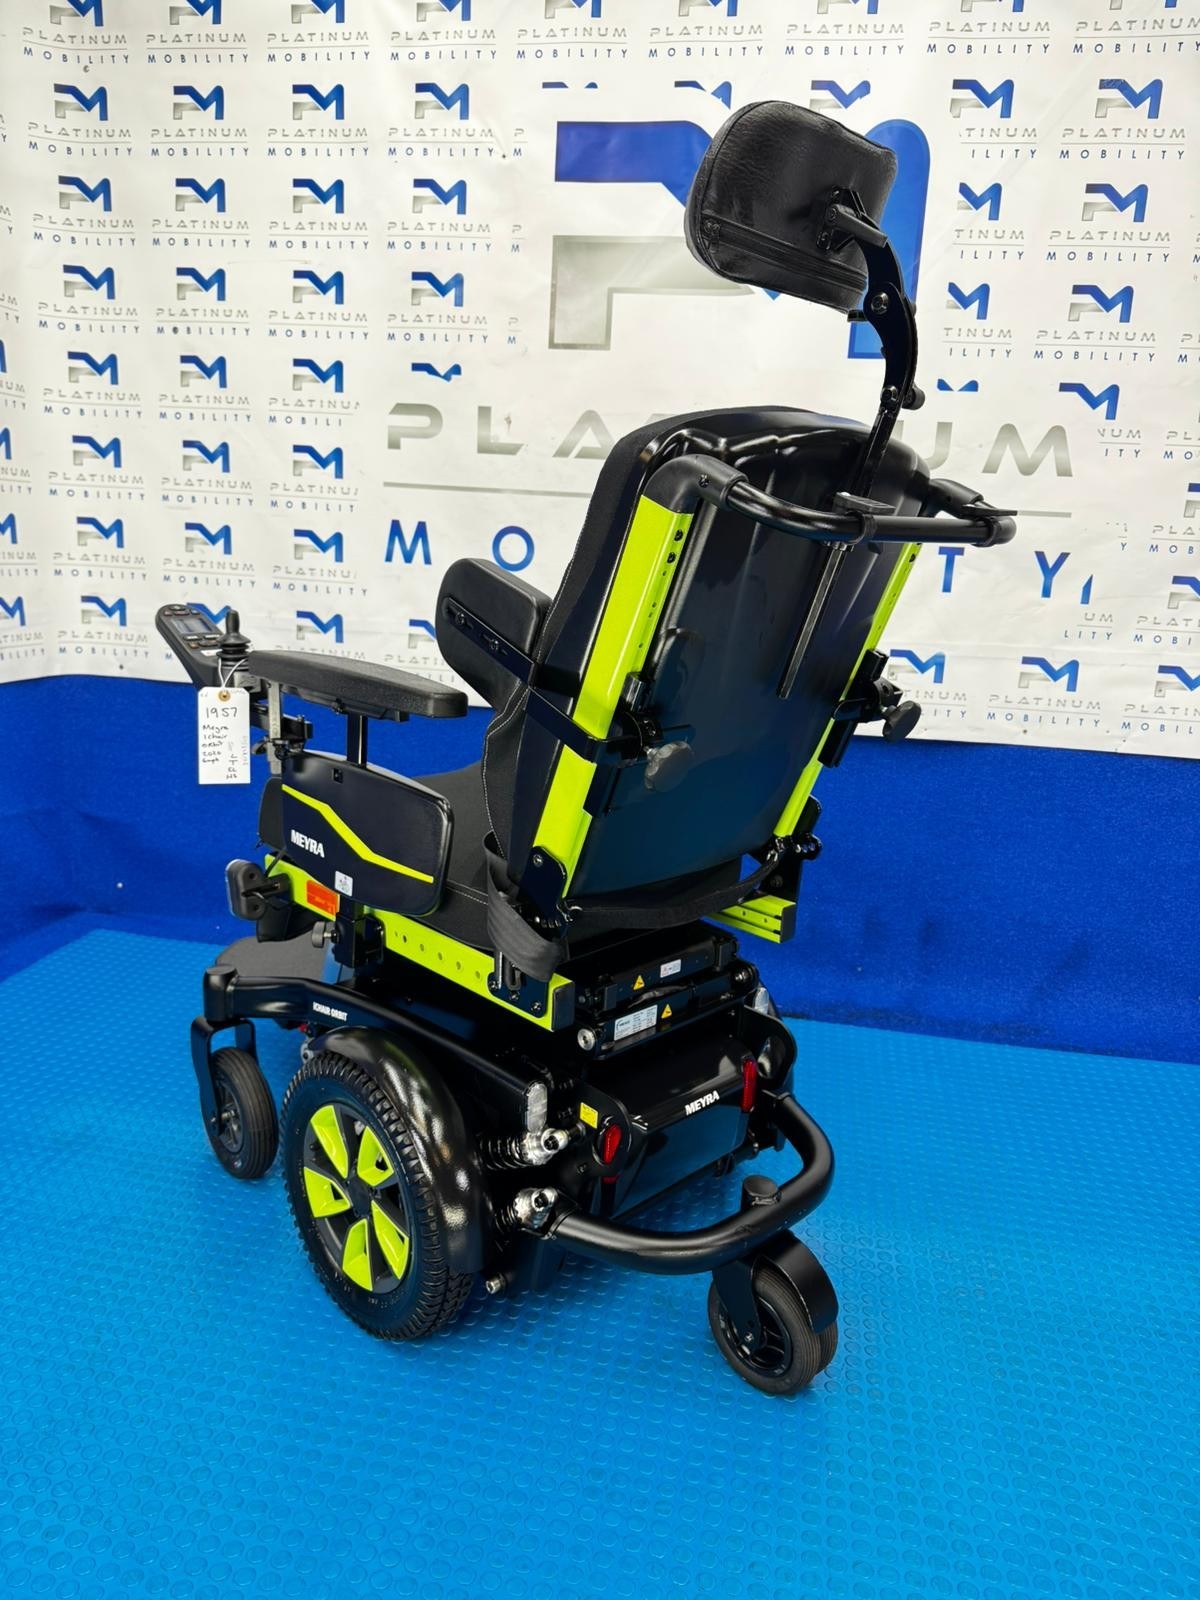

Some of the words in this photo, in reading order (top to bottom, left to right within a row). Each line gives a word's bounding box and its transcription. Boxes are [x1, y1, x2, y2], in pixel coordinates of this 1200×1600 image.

[518, 27, 626, 38] PLATINUM
[650, 24, 762, 37] PLATINUM
[787, 24, 904, 34] PLATINUM
[930, 22, 1050, 32] PLATINUM
[23, 27, 126, 45] PLATINUM
[146, 33, 246, 43] PLATINUM
[267, 32, 368, 43] PLATINUM
[391, 29, 496, 40] PLATINUM
[516, 48, 627, 58] MOBILITY
[649, 46, 763, 58] MOBILITY
[785, 45, 904, 56] MOBILITY
[927, 44, 1049, 54] MOBILITY
[24, 46, 128, 64] MOBILITY
[148, 54, 248, 63] MOBILITY
[268, 52, 370, 62] MOBILITY
[390, 50, 496, 60] MOBILITY
[28, 122, 131, 138] PLATINUM
[151, 128, 247, 138] PLATINUM
[268, 128, 367, 137] PLATINUM
[388, 128, 494, 137] PLATINUM
[960, 128, 1037, 138] TINUM
[1062, 128, 1185, 138] PLATINUM
[29, 141, 132, 156] MOBILITY
[151, 148, 248, 156] MOBILITY
[268, 148, 368, 156] MOBILITY
[388, 147, 493, 156] MOBILITY
[1060, 149, 1184, 159] MOBILITY
[33, 214, 134, 228] PLATINUM
[152, 219, 248, 229] PLATINUM
[269, 221, 367, 230] PLATINUM
[388, 221, 490, 232] PLATINUM
[34, 232, 136, 246] MOBILITY
[1050, 230, 1170, 242] PLATINUM
[152, 238, 250, 248] MOBILITY
[269, 240, 368, 249] MOBILITY
[387, 241, 491, 251] MOBILITY
[1046, 252, 1169, 262] MOBILITY
[38, 302, 138, 317] PLATINUM
[156, 308, 248, 318] PLATINUM
[269, 310, 367, 322] PLATINUM
[388, 314, 487, 324] PLATINUM
[39, 320, 139, 333] MOBILITY
[157, 326, 249, 336] MOBILITY
[268, 329, 368, 340] MOBILITY
[387, 332, 488, 343] MOBILITY
[1036, 330, 1156, 342] PLATINUM
[1034, 350, 1155, 362] MOBILITY
[43, 388, 140, 401] PLATINUM
[159, 394, 250, 404] PLATINUM
[44, 406, 142, 418] MOBILITY
[160, 412, 251, 422] MOBILITY
[48, 471, 144, 484] PLATINUM
[161, 477, 252, 490] PLATINUM
[49, 488, 144, 500] MOBILITY
[162, 494, 254, 506] MOBILITY
[53, 552, 146, 566] PLATINUM
[163, 558, 254, 571] PLATINUM
[54, 569, 147, 581] MOBILITY
[163, 574, 256, 588] MOBILITY
[273, 582, 367, 596] MOBILITY
[0, 632, 43, 644] TINUM
[57, 630, 148, 644] PLATINUM
[59, 646, 148, 658] MOBILITY
[904, 689, 966, 701] TINUM
[989, 694, 1100, 710] PLATINUM
[206, 706, 238, 718] 1957
[987, 712, 1100, 727] MOBILITY
[291, 829, 325, 858] MEYRA
[684, 1090, 720, 1116] MEYRA
